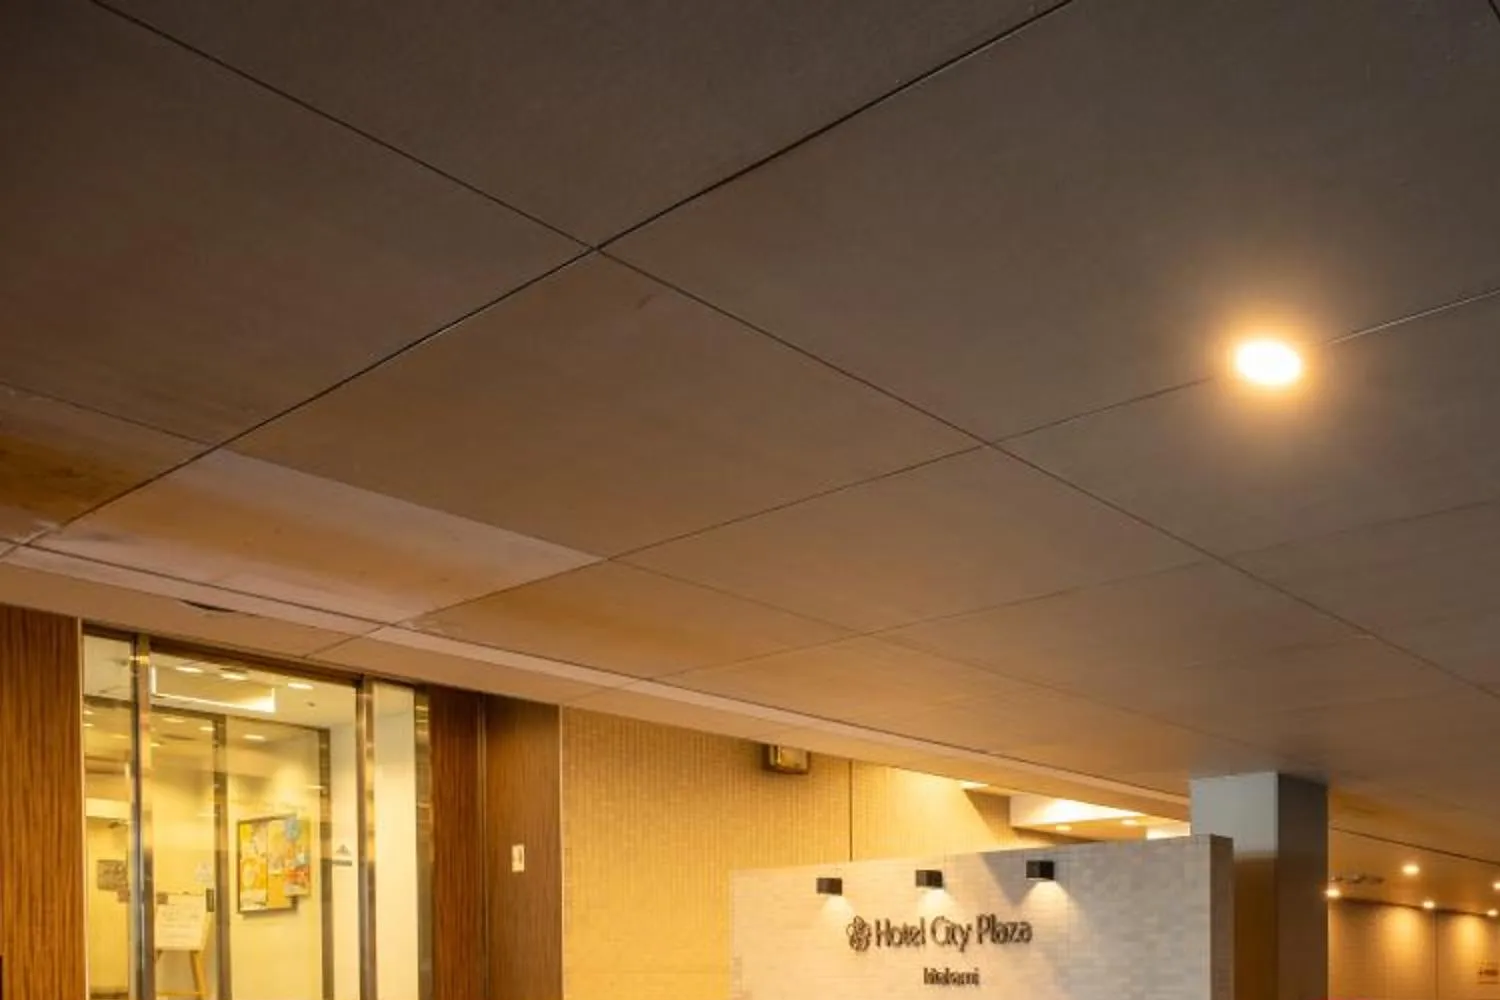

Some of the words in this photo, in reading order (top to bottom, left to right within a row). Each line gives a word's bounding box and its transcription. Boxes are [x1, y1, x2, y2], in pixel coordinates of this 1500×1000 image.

[875, 918, 926, 948] Hotel
[930, 916, 972, 952] City
[976, 913, 1033, 945] Plaza
